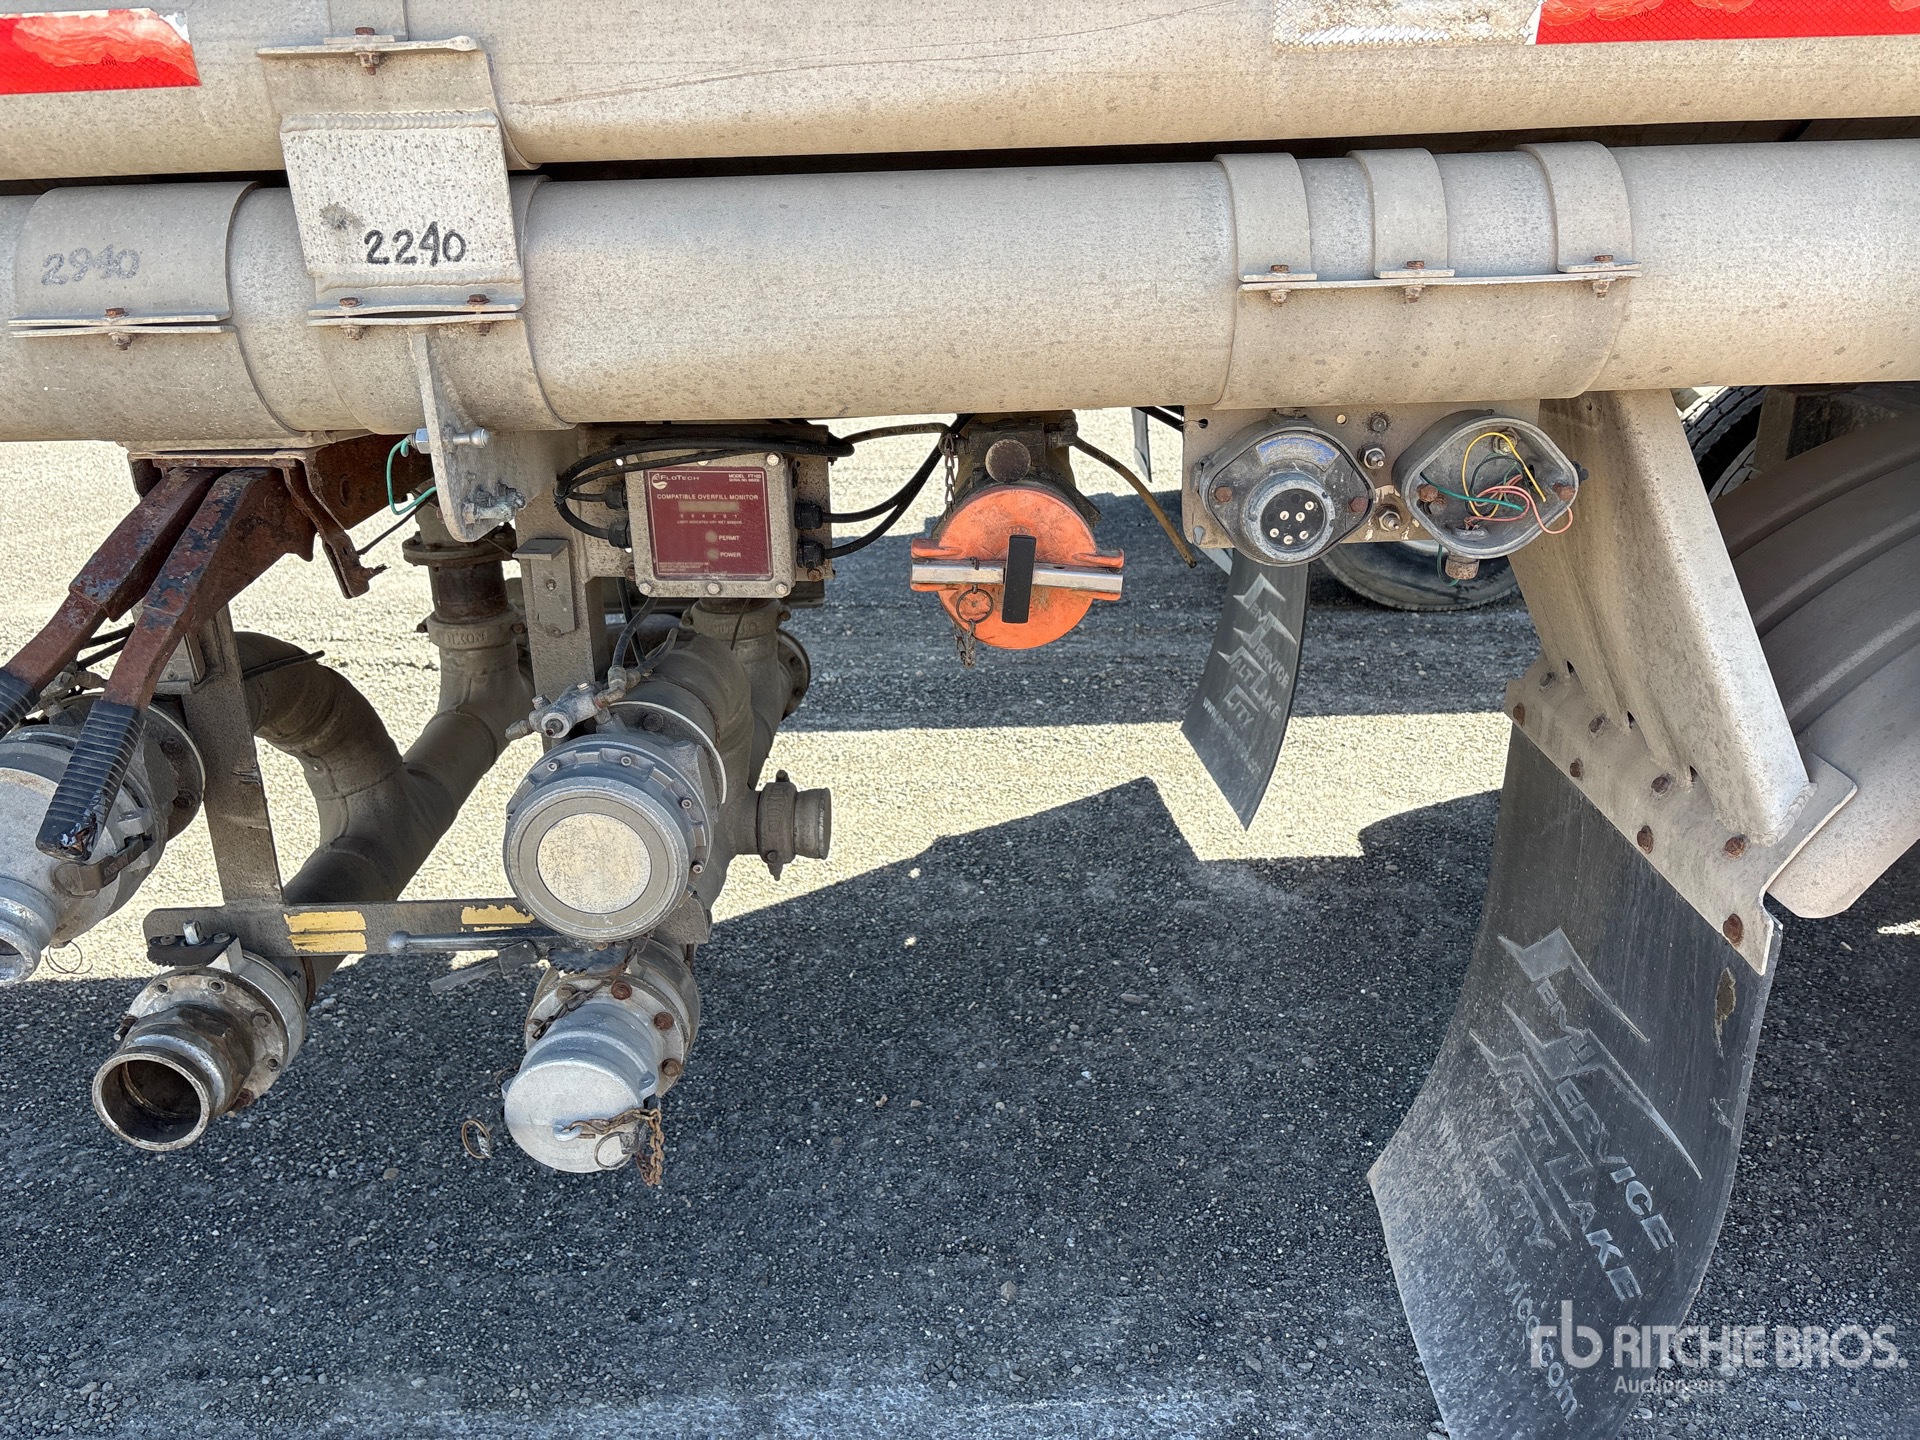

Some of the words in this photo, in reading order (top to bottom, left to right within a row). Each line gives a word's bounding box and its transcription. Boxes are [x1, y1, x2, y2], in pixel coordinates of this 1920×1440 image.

[364, 221, 467, 267] 2240
[1248, 671, 1282, 720] LAKE
[1544, 1153, 1644, 1300] LAKE
